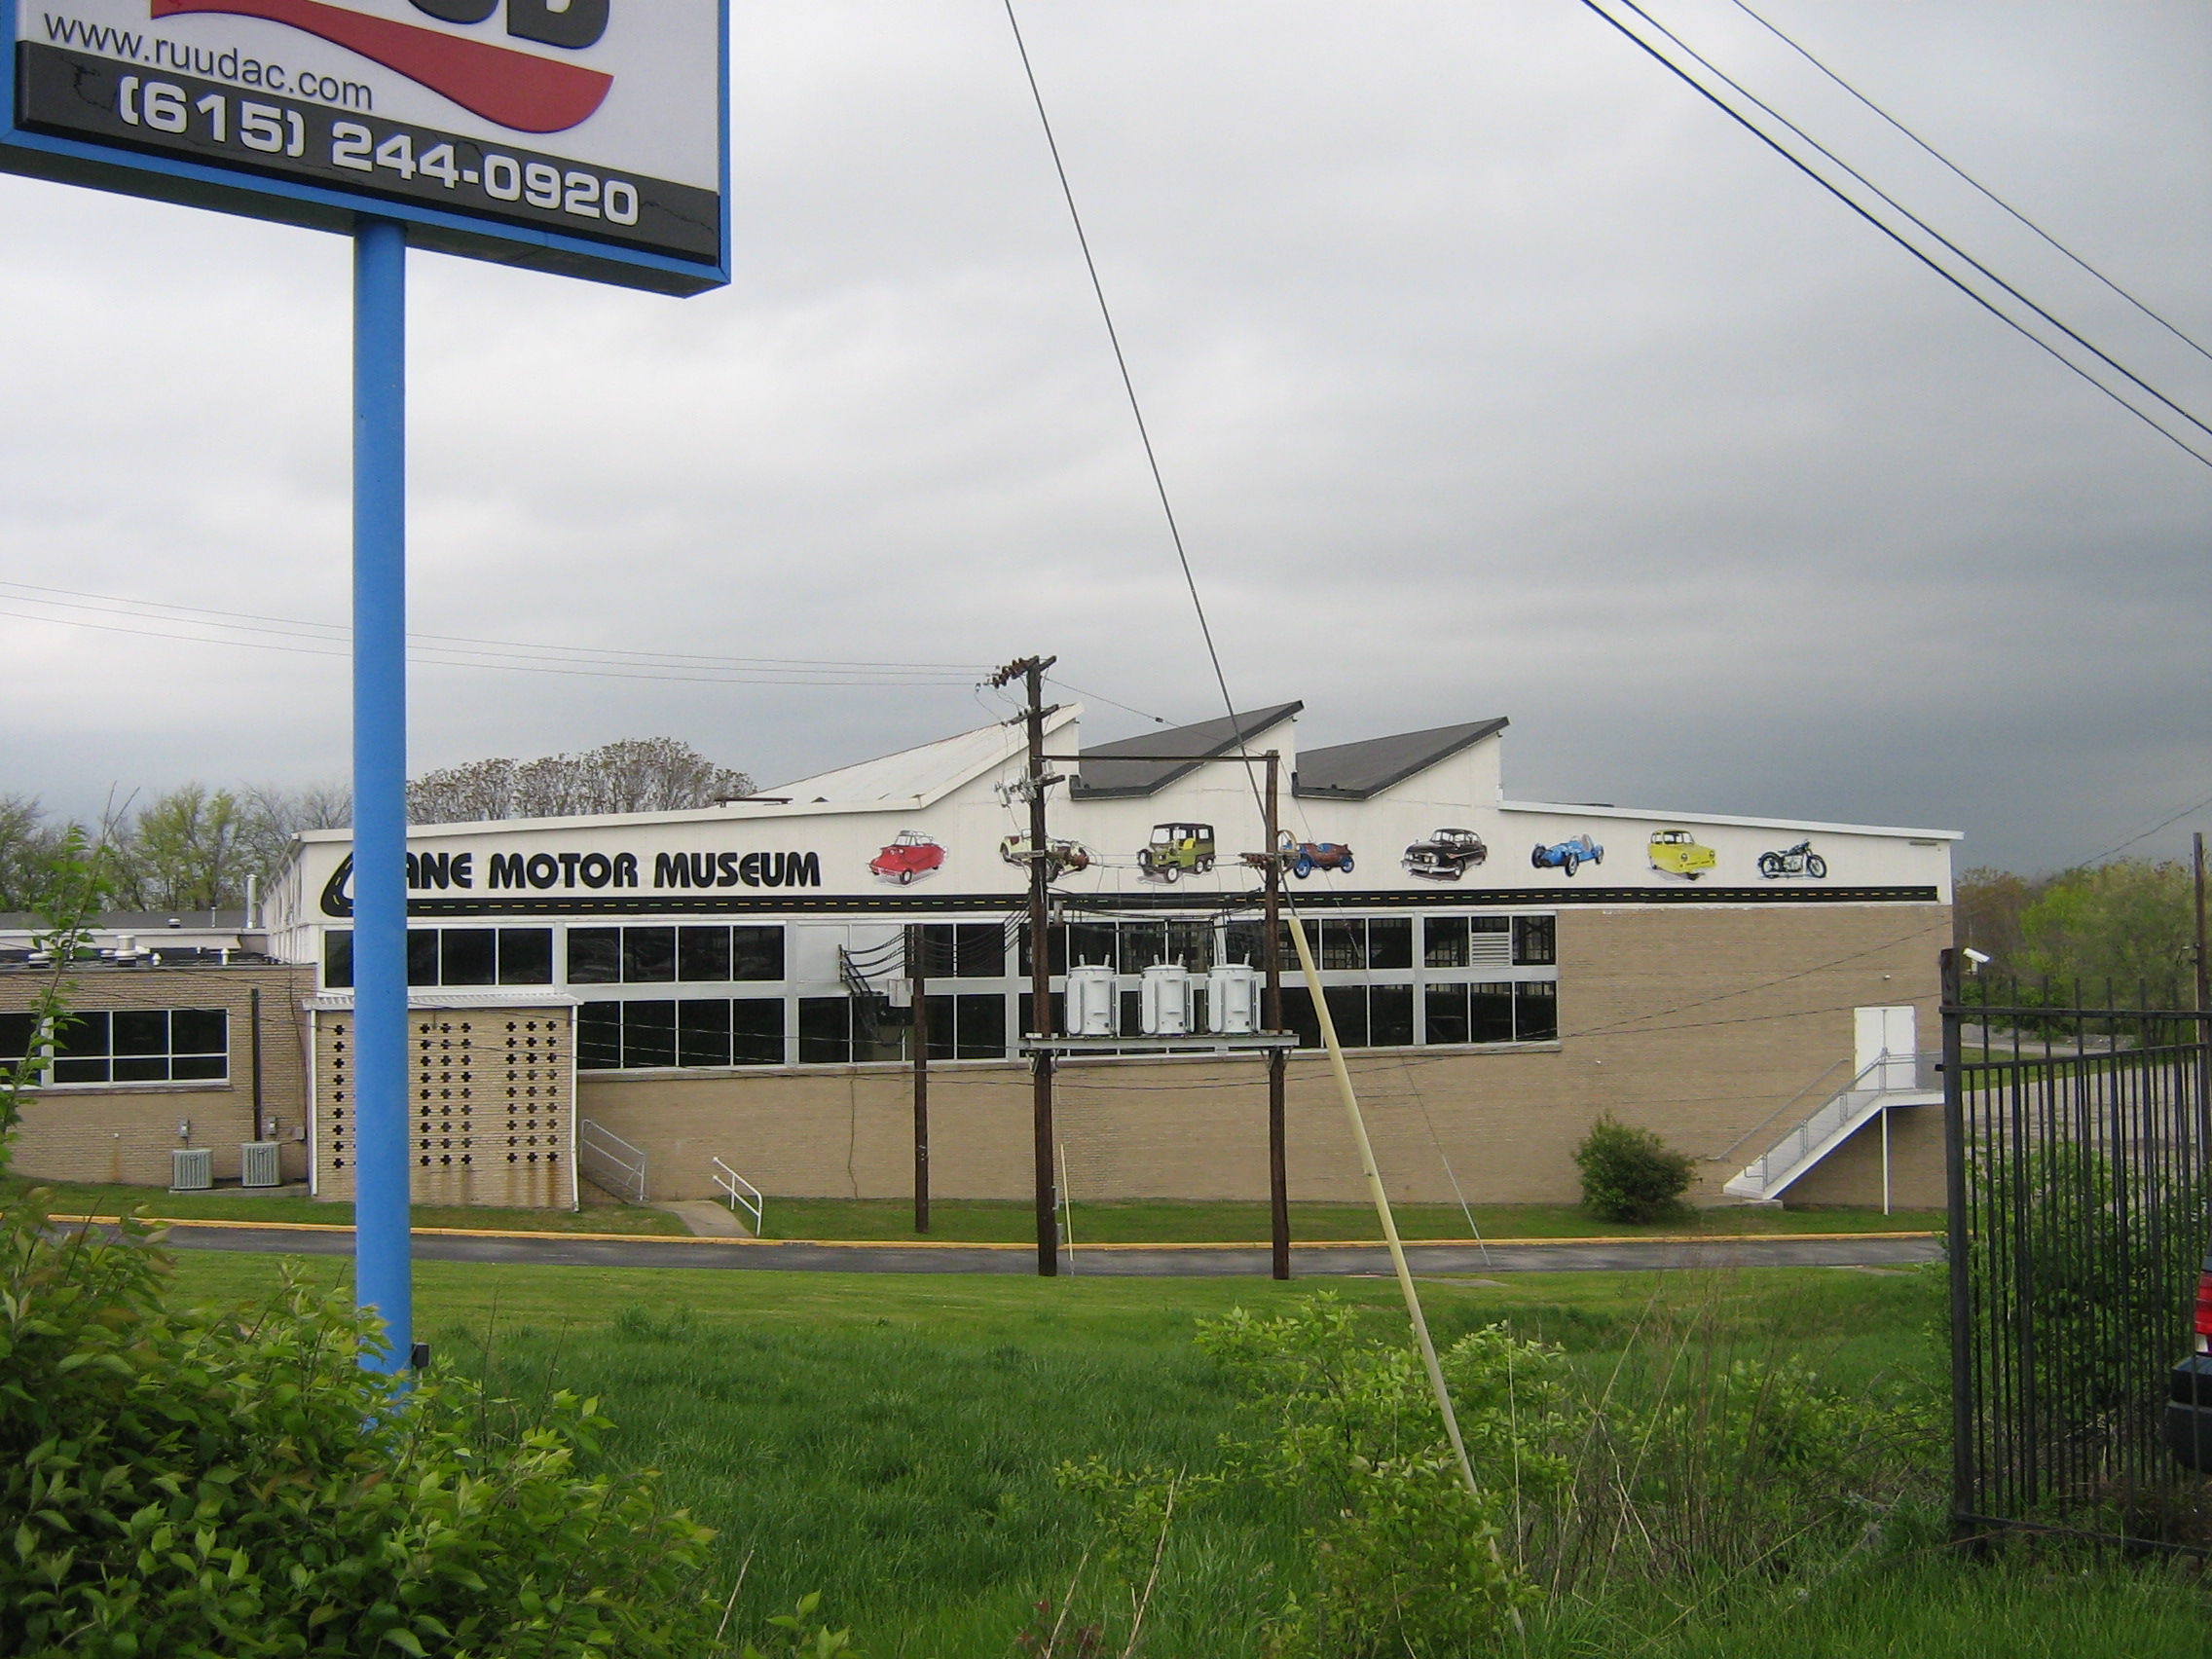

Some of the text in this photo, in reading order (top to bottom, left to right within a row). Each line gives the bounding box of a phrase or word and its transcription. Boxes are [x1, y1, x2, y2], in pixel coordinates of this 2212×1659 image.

[44, 12, 374, 111] www.ruudac.com
[118, 75, 640, 228] (615) 244-0920
[488, 852, 639, 890] MOTOR
[653, 851, 822, 888] MUSEUM
